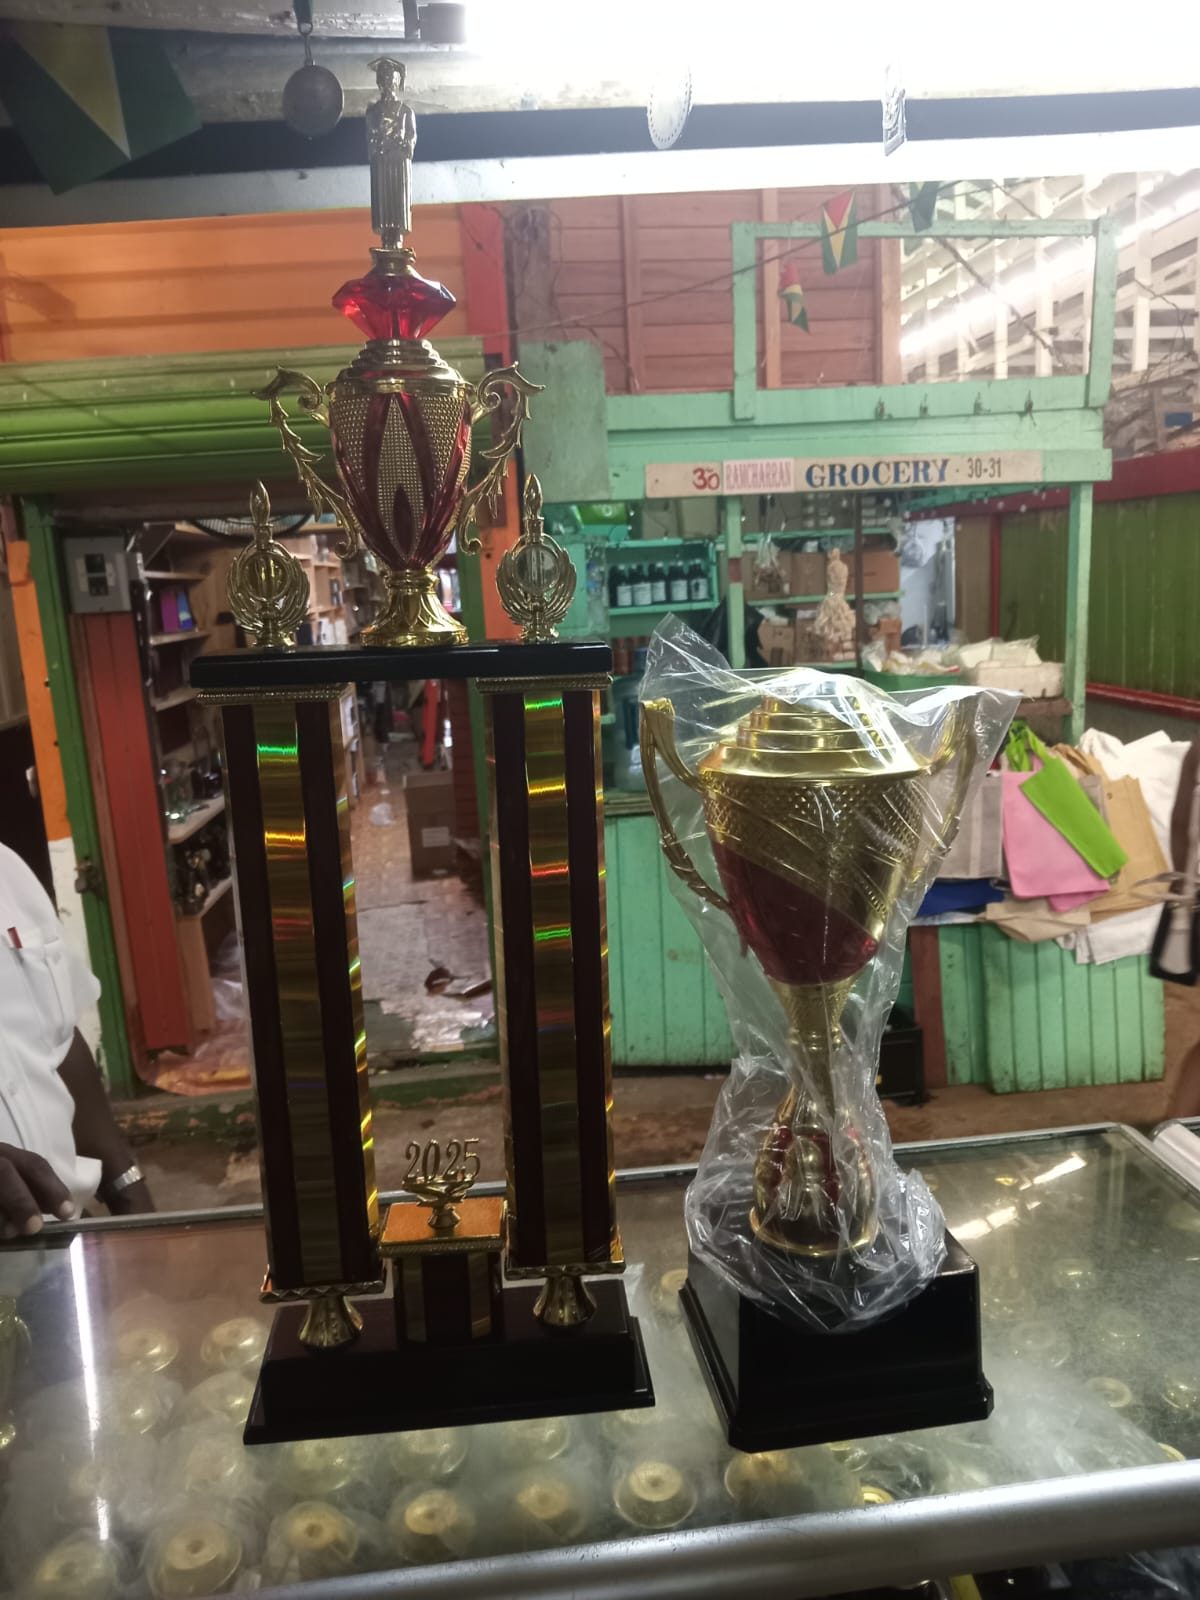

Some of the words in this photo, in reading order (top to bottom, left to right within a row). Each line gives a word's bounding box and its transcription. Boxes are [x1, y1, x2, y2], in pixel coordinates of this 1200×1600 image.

[805, 458, 949, 488] GROCERY
[967, 457, 1001, 478] 30-31
[404, 1138, 480, 1182] 2025
